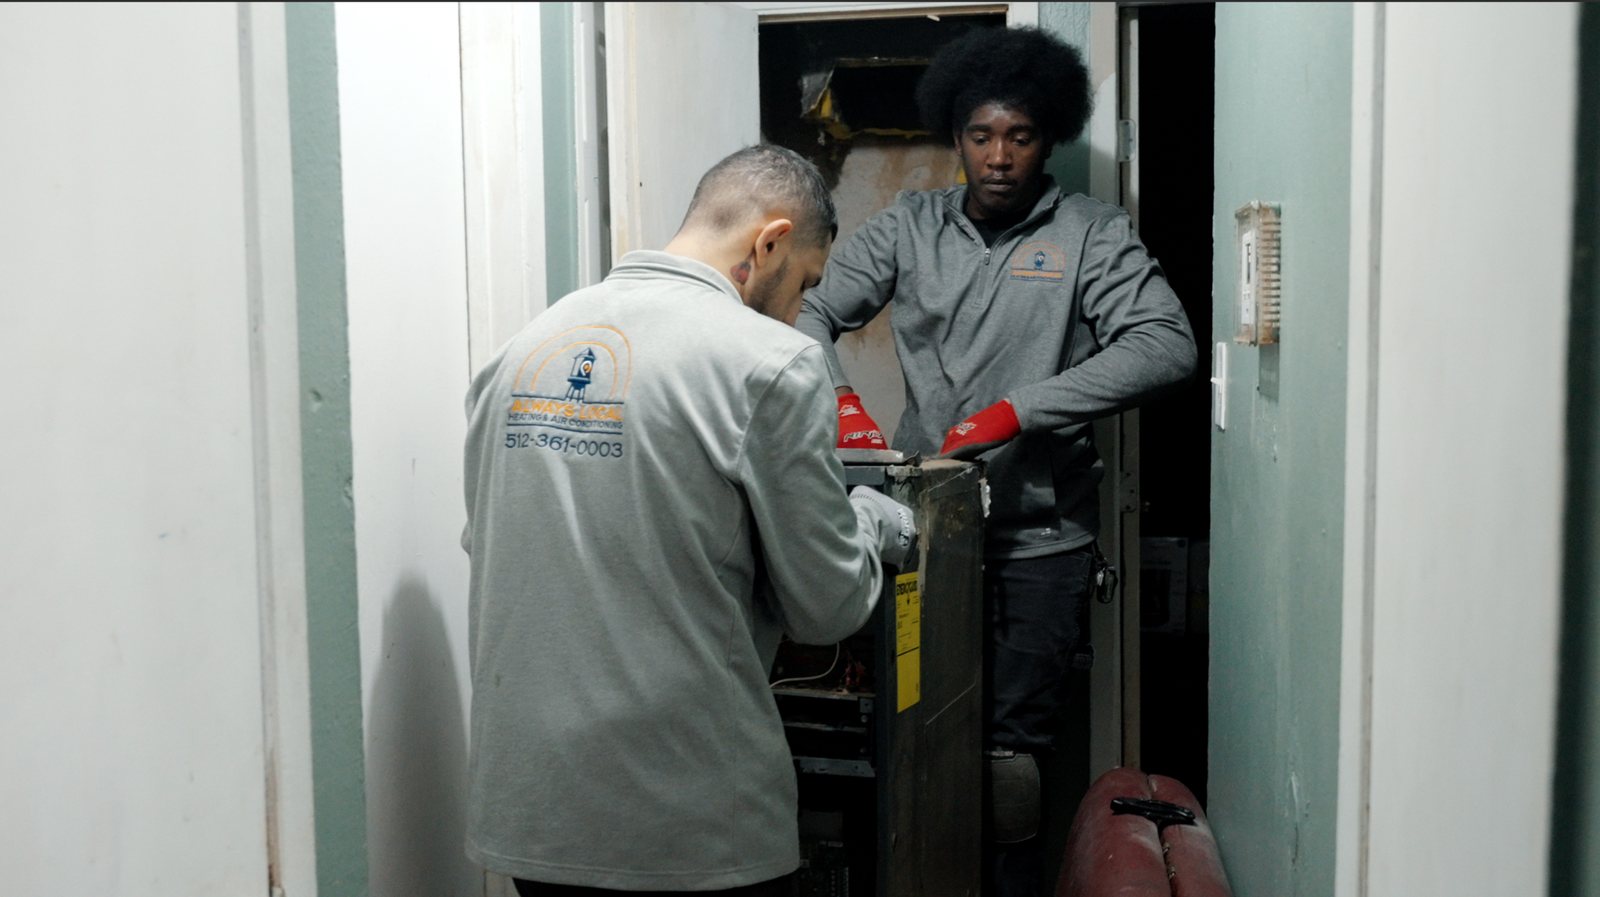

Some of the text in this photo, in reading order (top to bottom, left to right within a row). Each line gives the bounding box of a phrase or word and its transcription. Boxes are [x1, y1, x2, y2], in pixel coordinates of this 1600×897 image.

[511, 399, 576, 417] ALWAYS
[508, 413, 543, 422] HEATING
[551, 416, 567, 425] AIR
[505, 433, 623, 458] 512-361-0003
